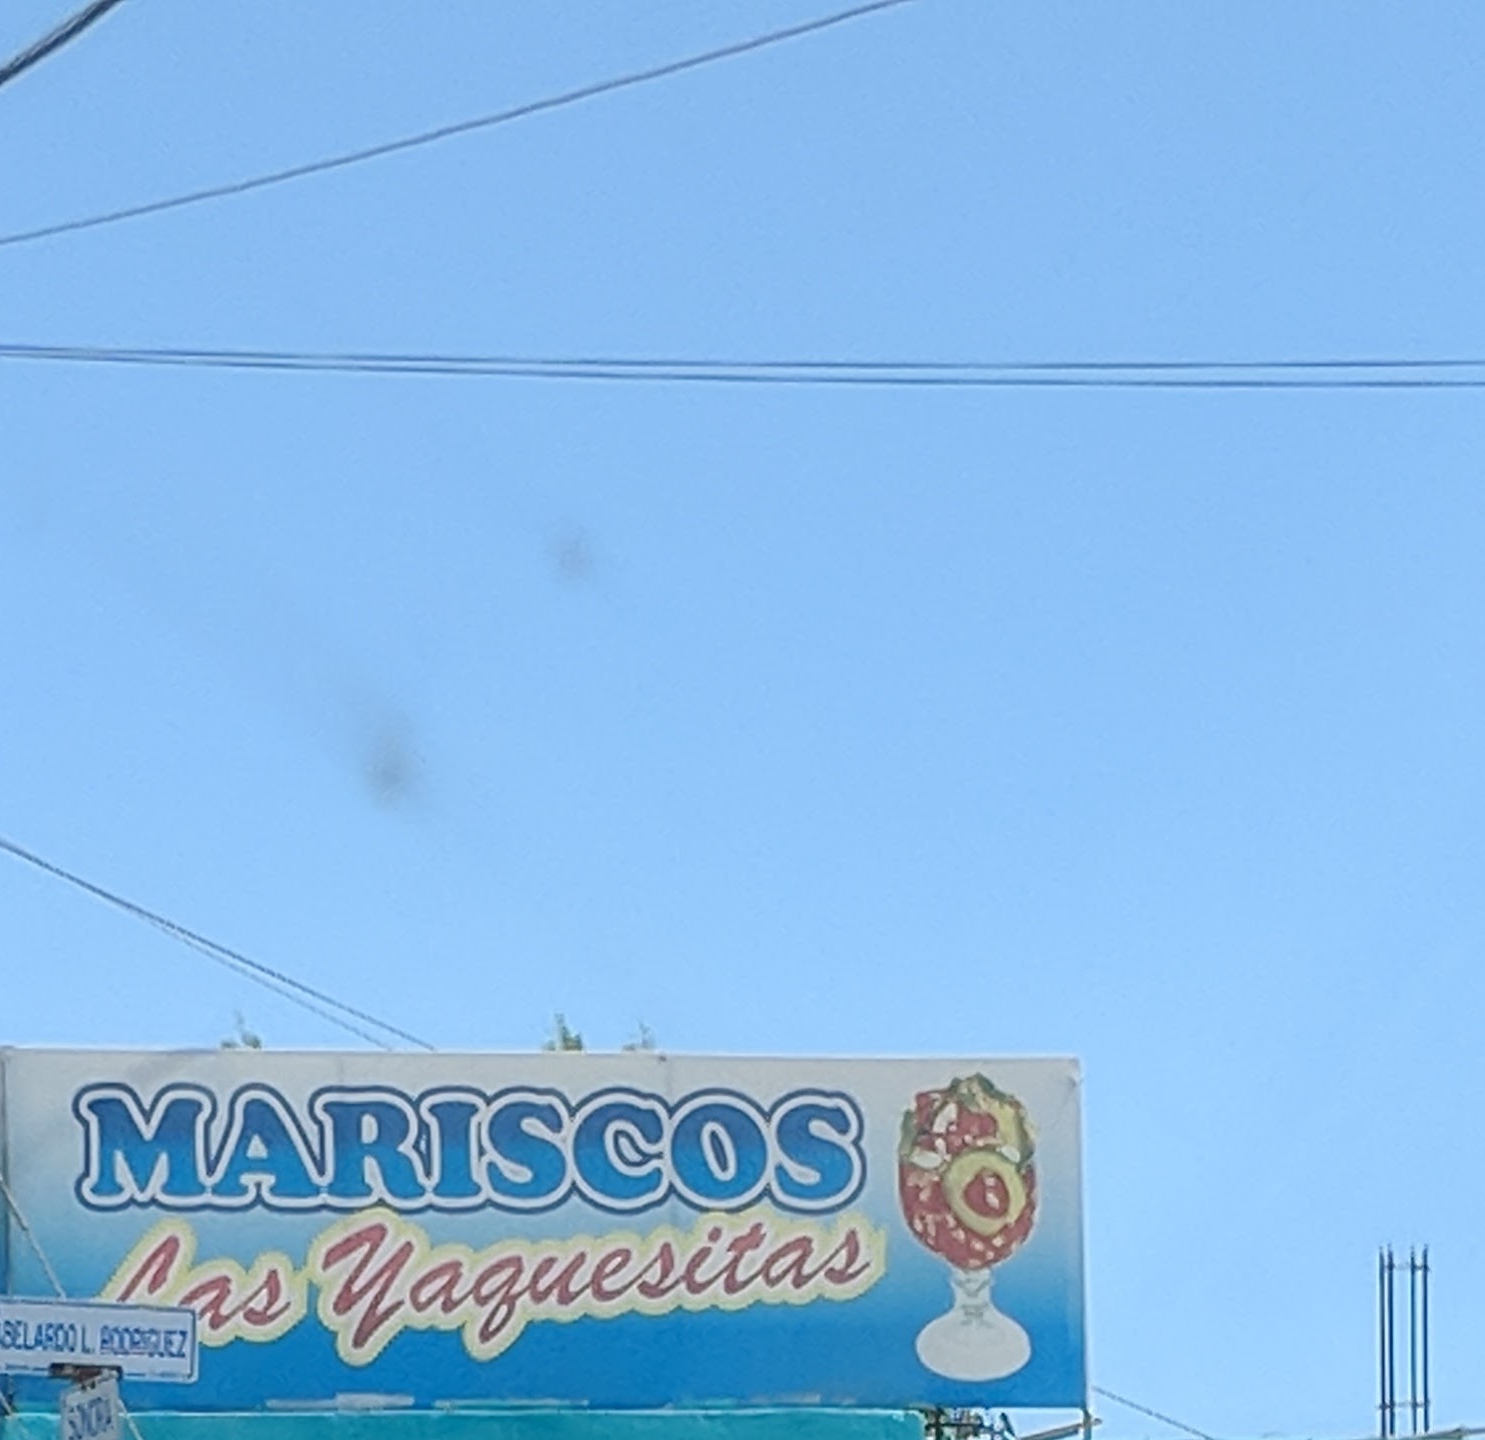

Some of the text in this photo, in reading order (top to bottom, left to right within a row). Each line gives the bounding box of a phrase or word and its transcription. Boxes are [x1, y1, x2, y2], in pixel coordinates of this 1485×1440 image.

[77, 1084, 862, 1211] MARISCOS
[81, 1323, 95, 1354] L.
[100, 1325, 188, 1358] RODRIGUEZ
[319, 1217, 877, 1353] Yaquesitas
